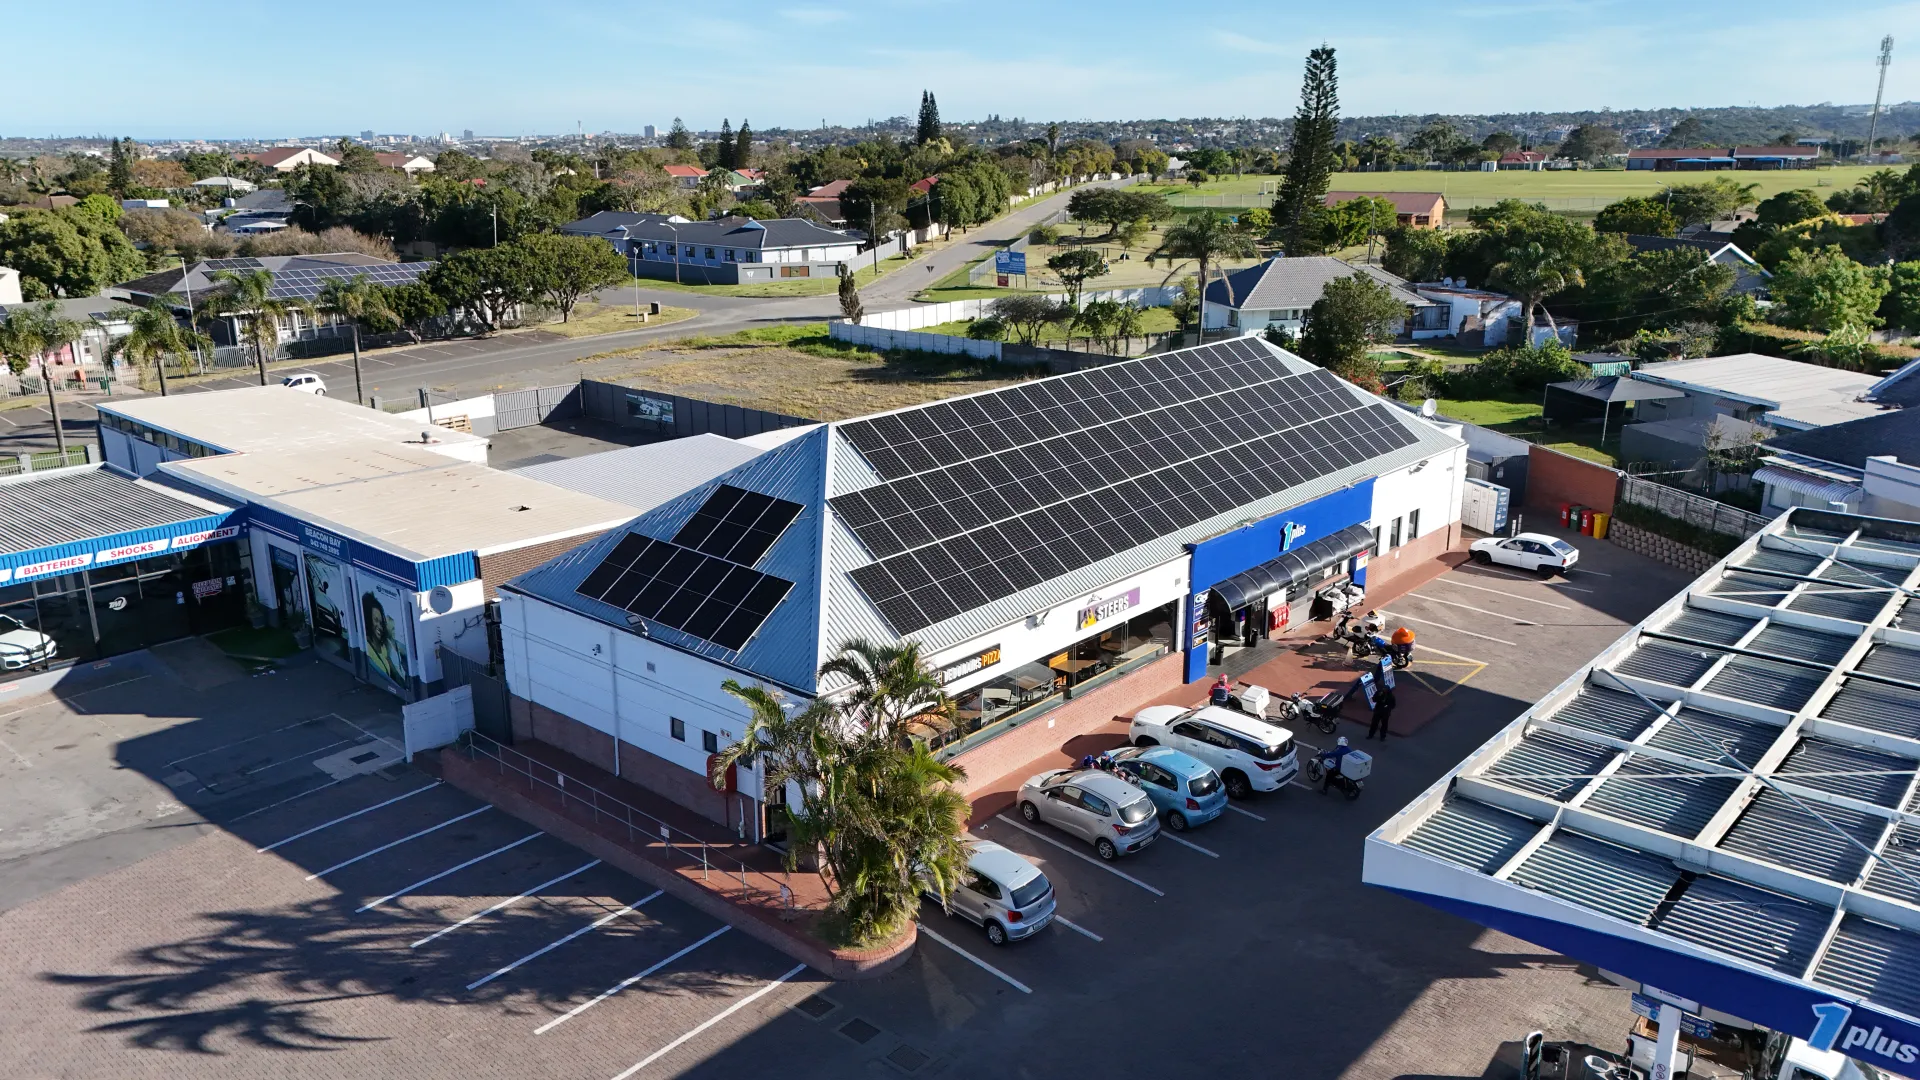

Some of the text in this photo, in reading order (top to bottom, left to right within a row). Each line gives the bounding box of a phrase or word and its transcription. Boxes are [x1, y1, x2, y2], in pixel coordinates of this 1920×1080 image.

[177, 527, 235, 546] ALIGNMENT
[304, 526, 341, 549] BEACON BAY
[110, 543, 154, 558] SHOCKS
[23, 557, 85, 576] BATTERIES
[1097, 595, 1129, 621] STEERS
[981, 648, 1000, 667] PIZZA
